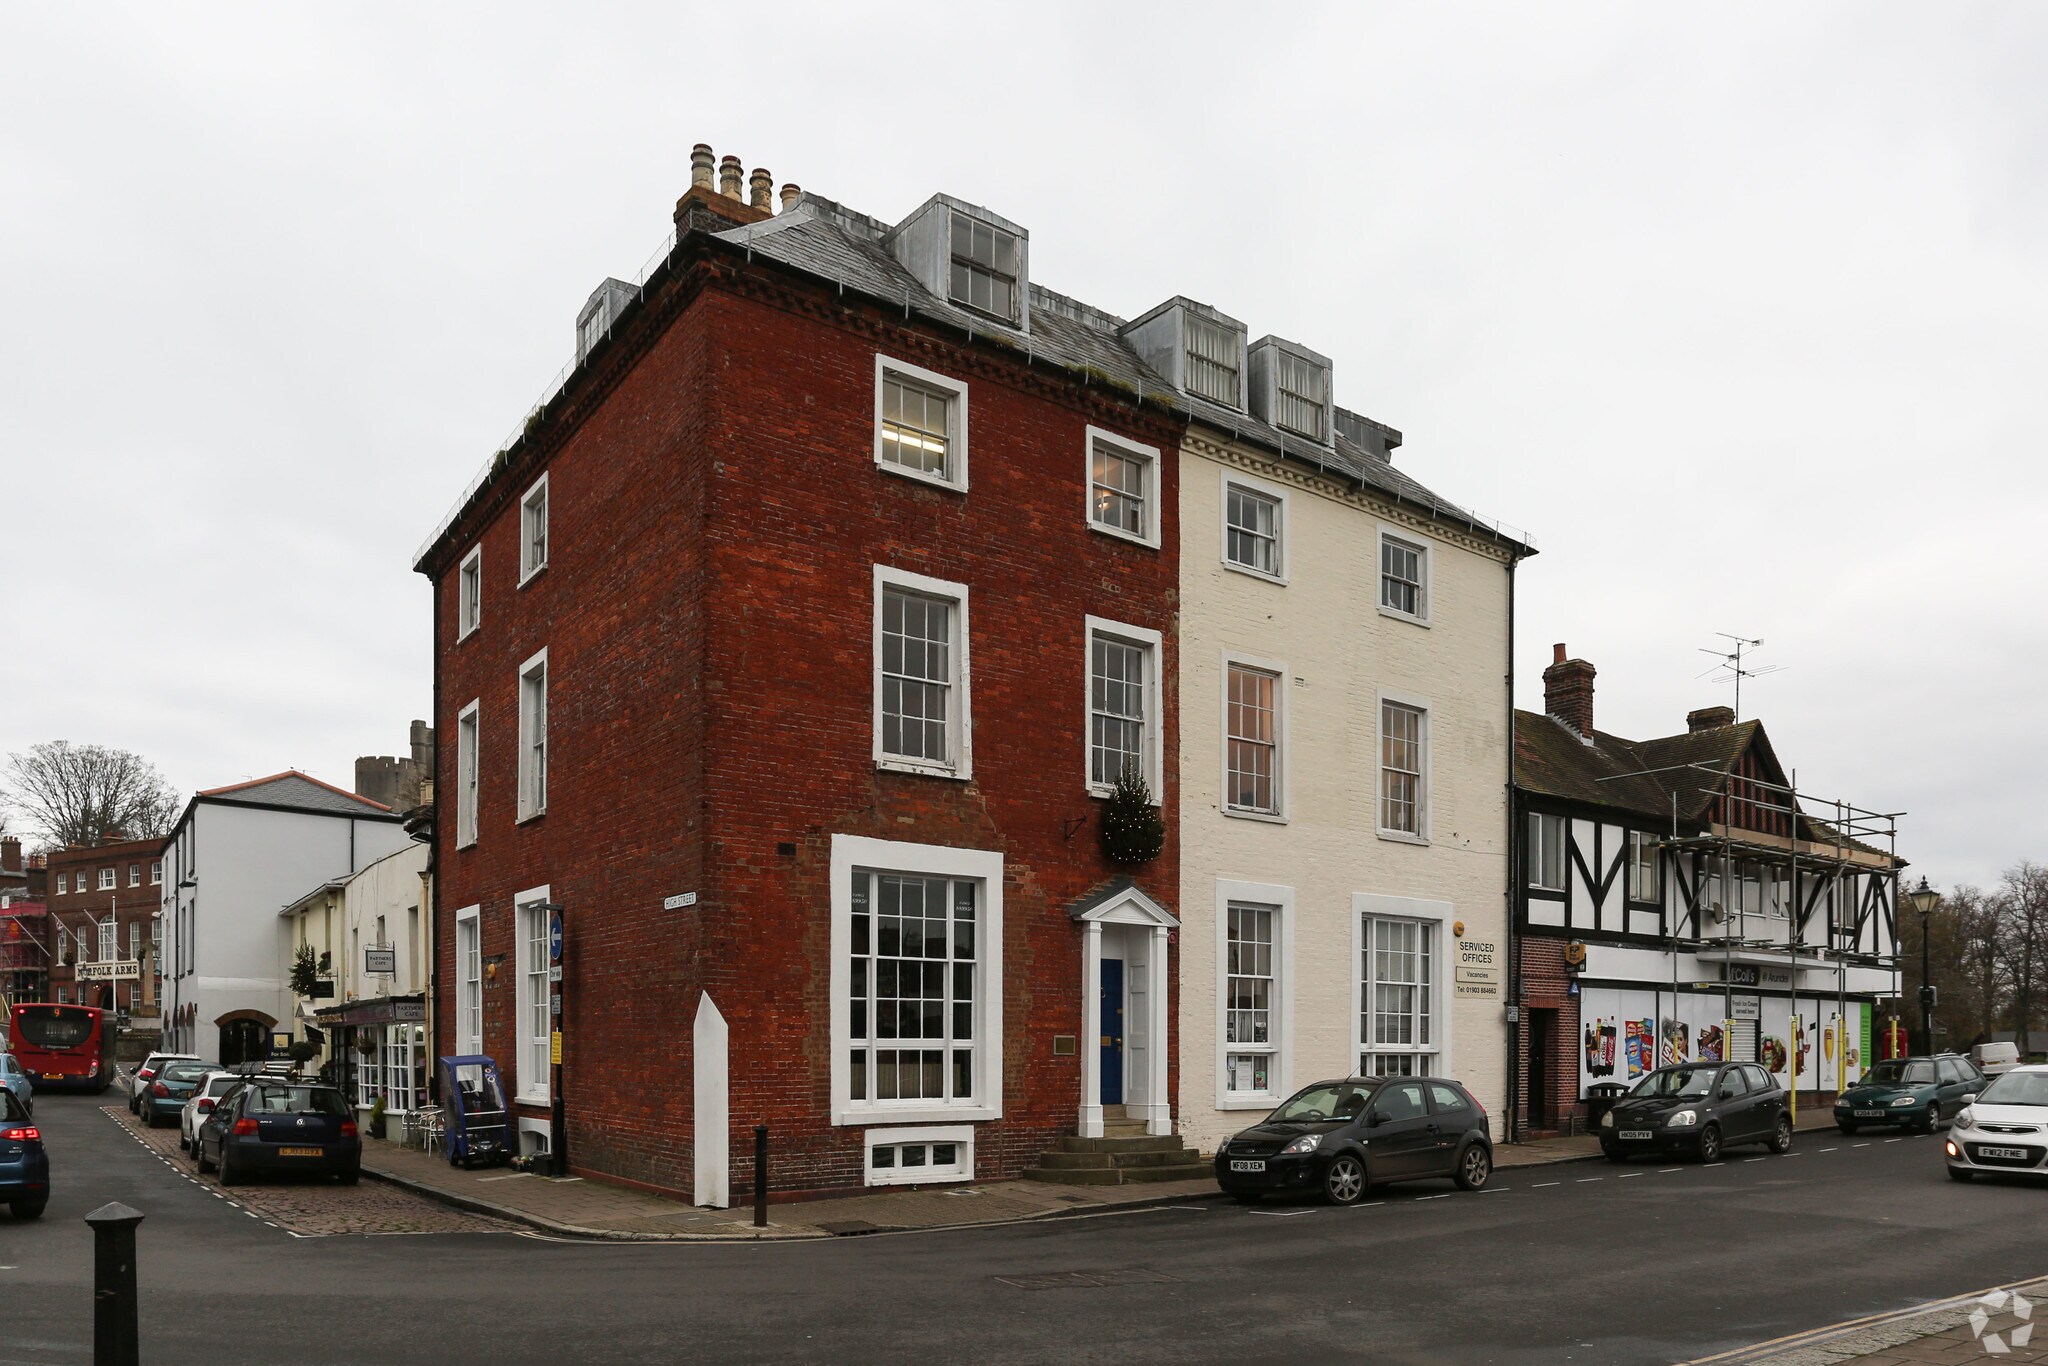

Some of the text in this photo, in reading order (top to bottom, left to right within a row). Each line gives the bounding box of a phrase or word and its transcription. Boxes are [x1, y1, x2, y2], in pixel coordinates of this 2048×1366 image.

[666, 893, 695, 908] HIGH STREET
[1459, 941, 1495, 953] SERVICED
[1462, 953, 1492, 964] OFFICES
[77, 965, 138, 977] NRFOLK ARMS
[1466, 971, 1489, 979] Vacancies
[54, 1008, 60, 1017] 9
